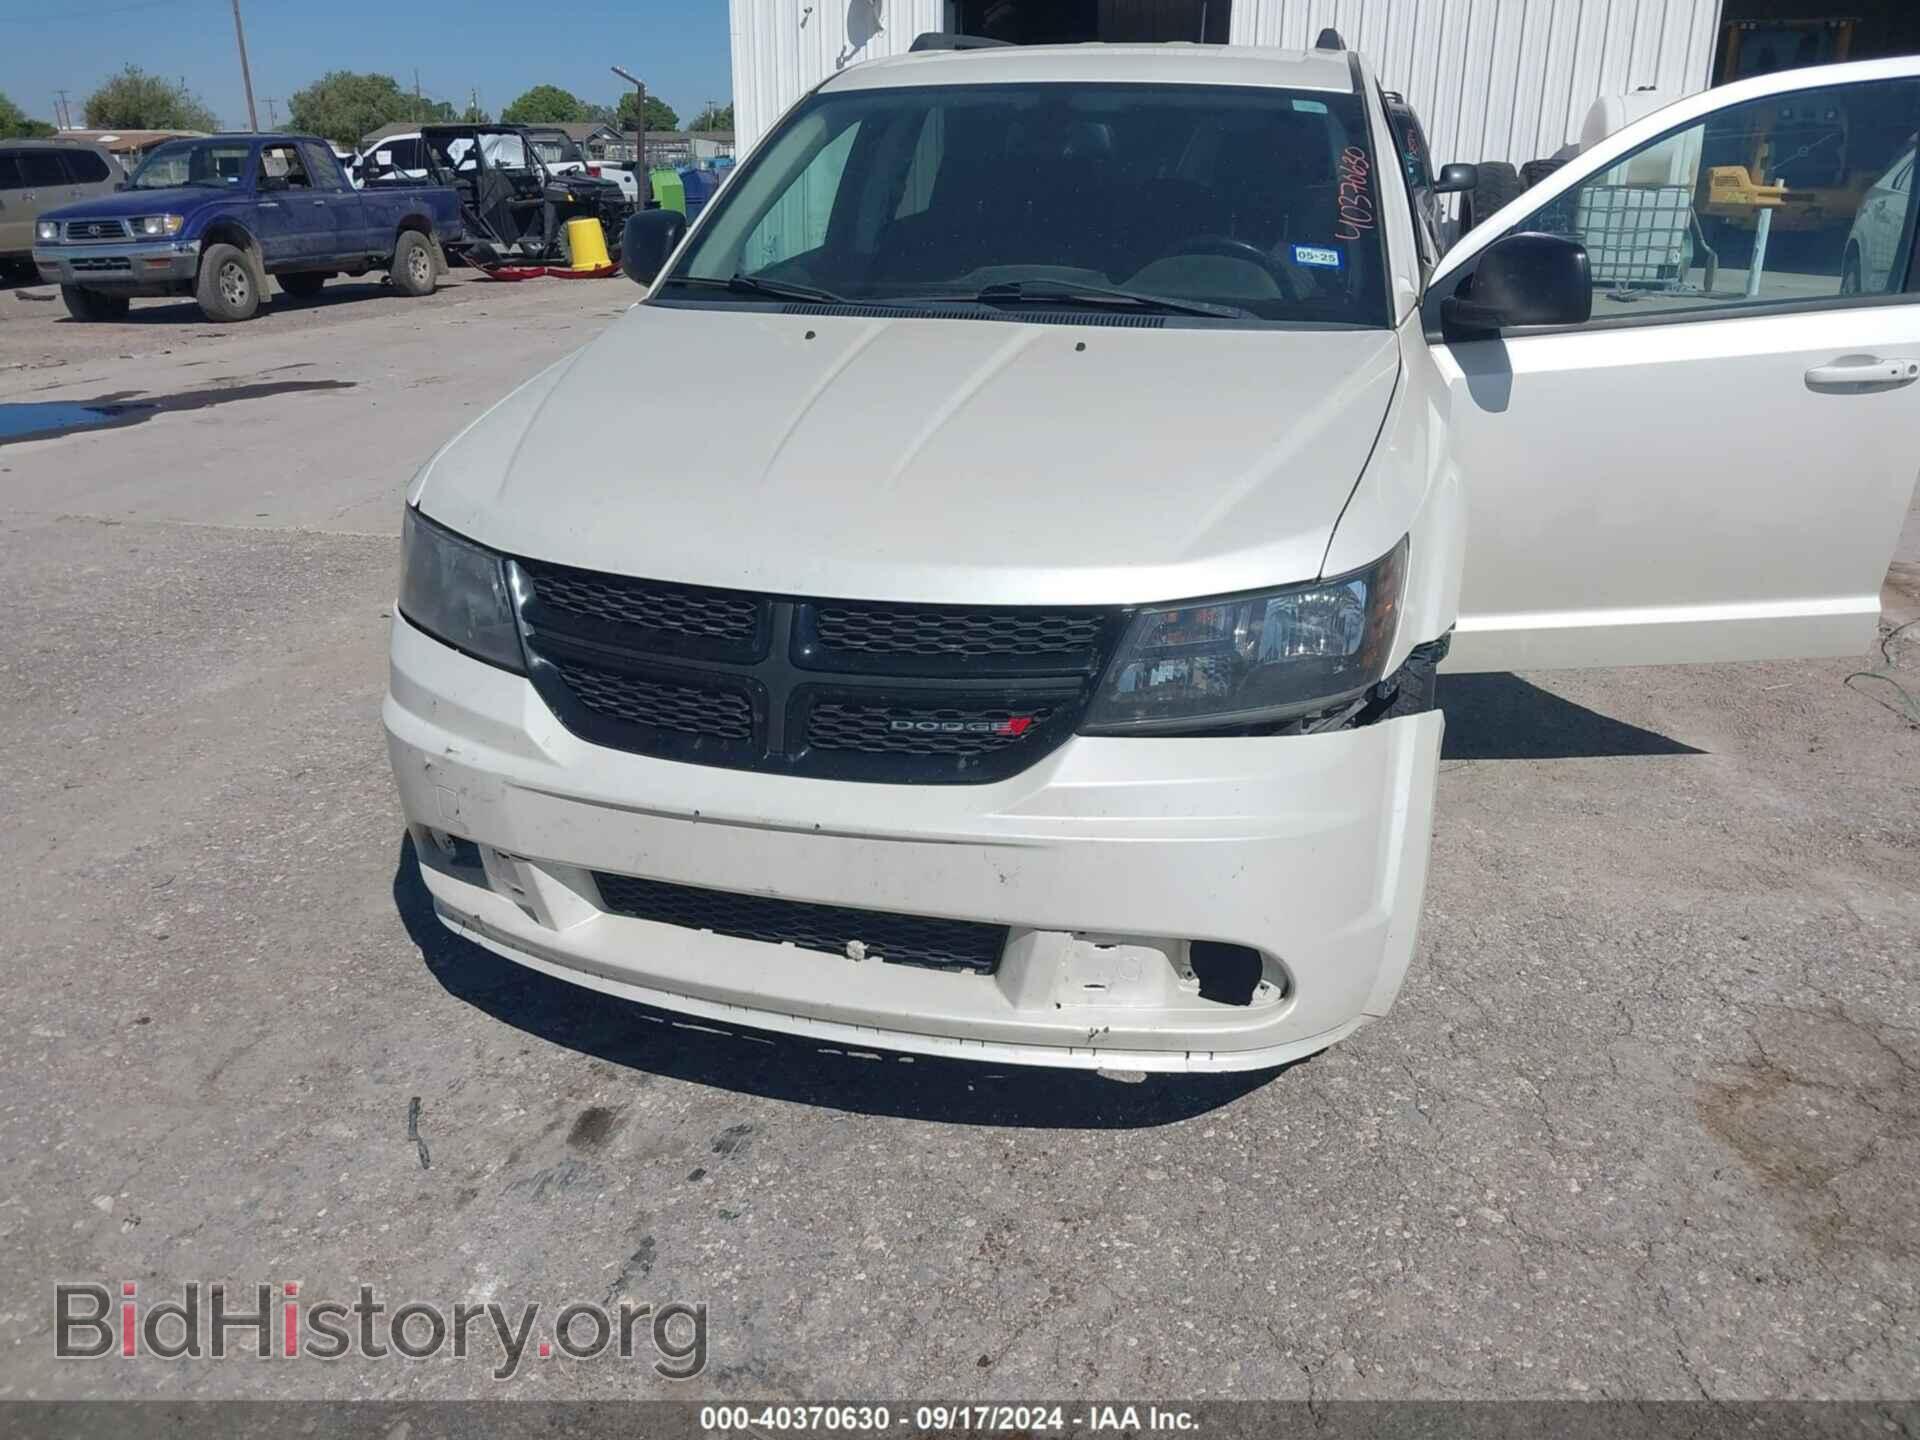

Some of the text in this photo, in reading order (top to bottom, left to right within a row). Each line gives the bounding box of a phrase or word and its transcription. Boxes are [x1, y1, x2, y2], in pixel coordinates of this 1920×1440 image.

[1335, 146, 1374, 240] 40370630
[1298, 250, 1337, 263] 05-25
[891, 720, 1012, 732] DODGE
